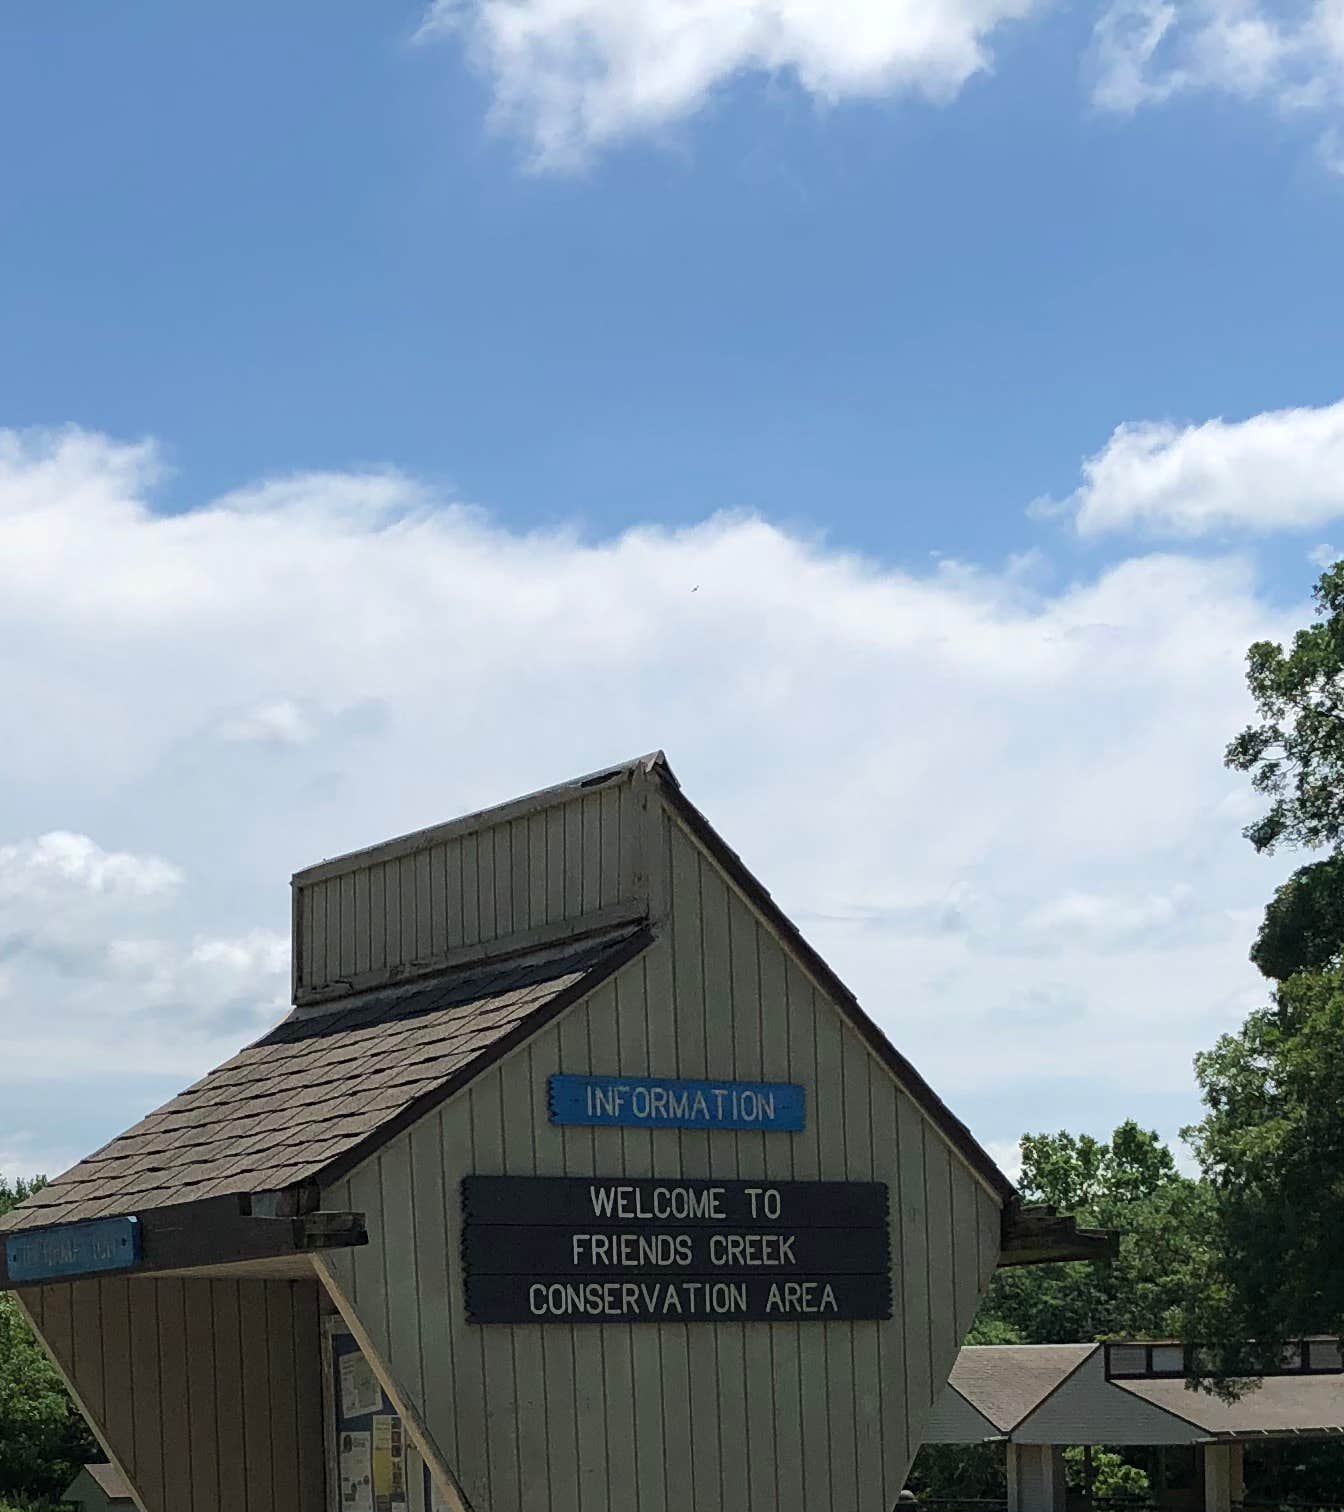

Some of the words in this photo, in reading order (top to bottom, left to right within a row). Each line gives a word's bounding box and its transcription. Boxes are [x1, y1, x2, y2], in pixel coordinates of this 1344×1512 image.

[586, 1085, 776, 1121] INFORMATION
[590, 1185, 727, 1220] WELCOME
[744, 1187, 782, 1219] TO
[572, 1234, 693, 1266] FRIENDS
[709, 1234, 797, 1265] CREEK
[528, 1282, 748, 1315] CONSERVATION
[764, 1282, 839, 1313] AREA
